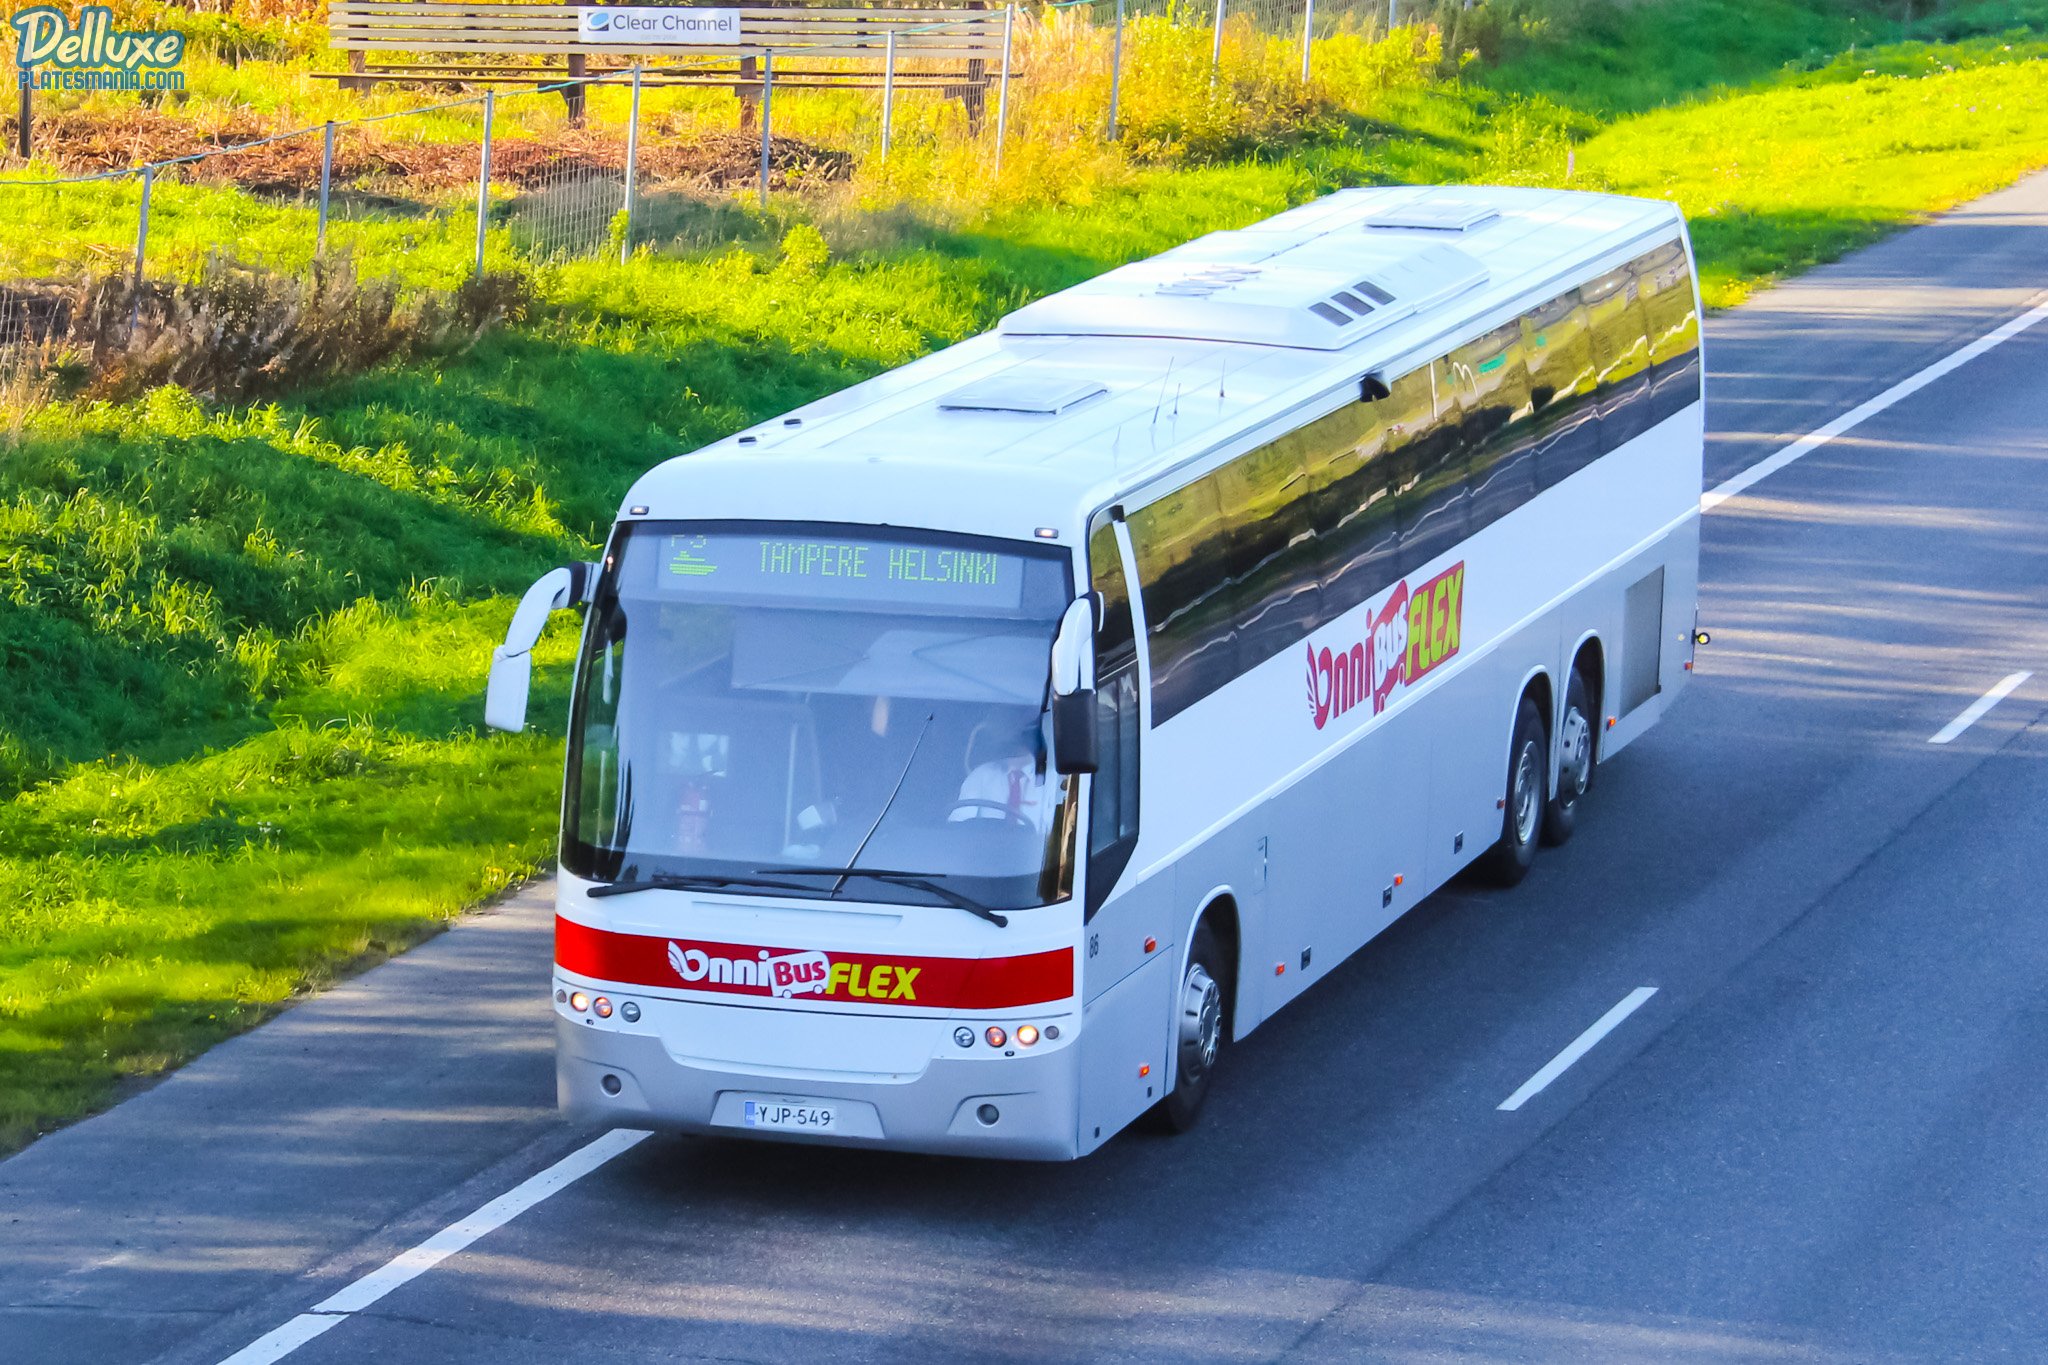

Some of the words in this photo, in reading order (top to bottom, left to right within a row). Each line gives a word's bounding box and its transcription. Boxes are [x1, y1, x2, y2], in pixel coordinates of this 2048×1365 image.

[613, 14, 658, 31] Clear
[662, 15, 732, 32] Channel
[760, 541, 869, 577] TAMPERE
[888, 548, 998, 585] HELSINKI
[758, 1106, 832, 1127] YJP-549
